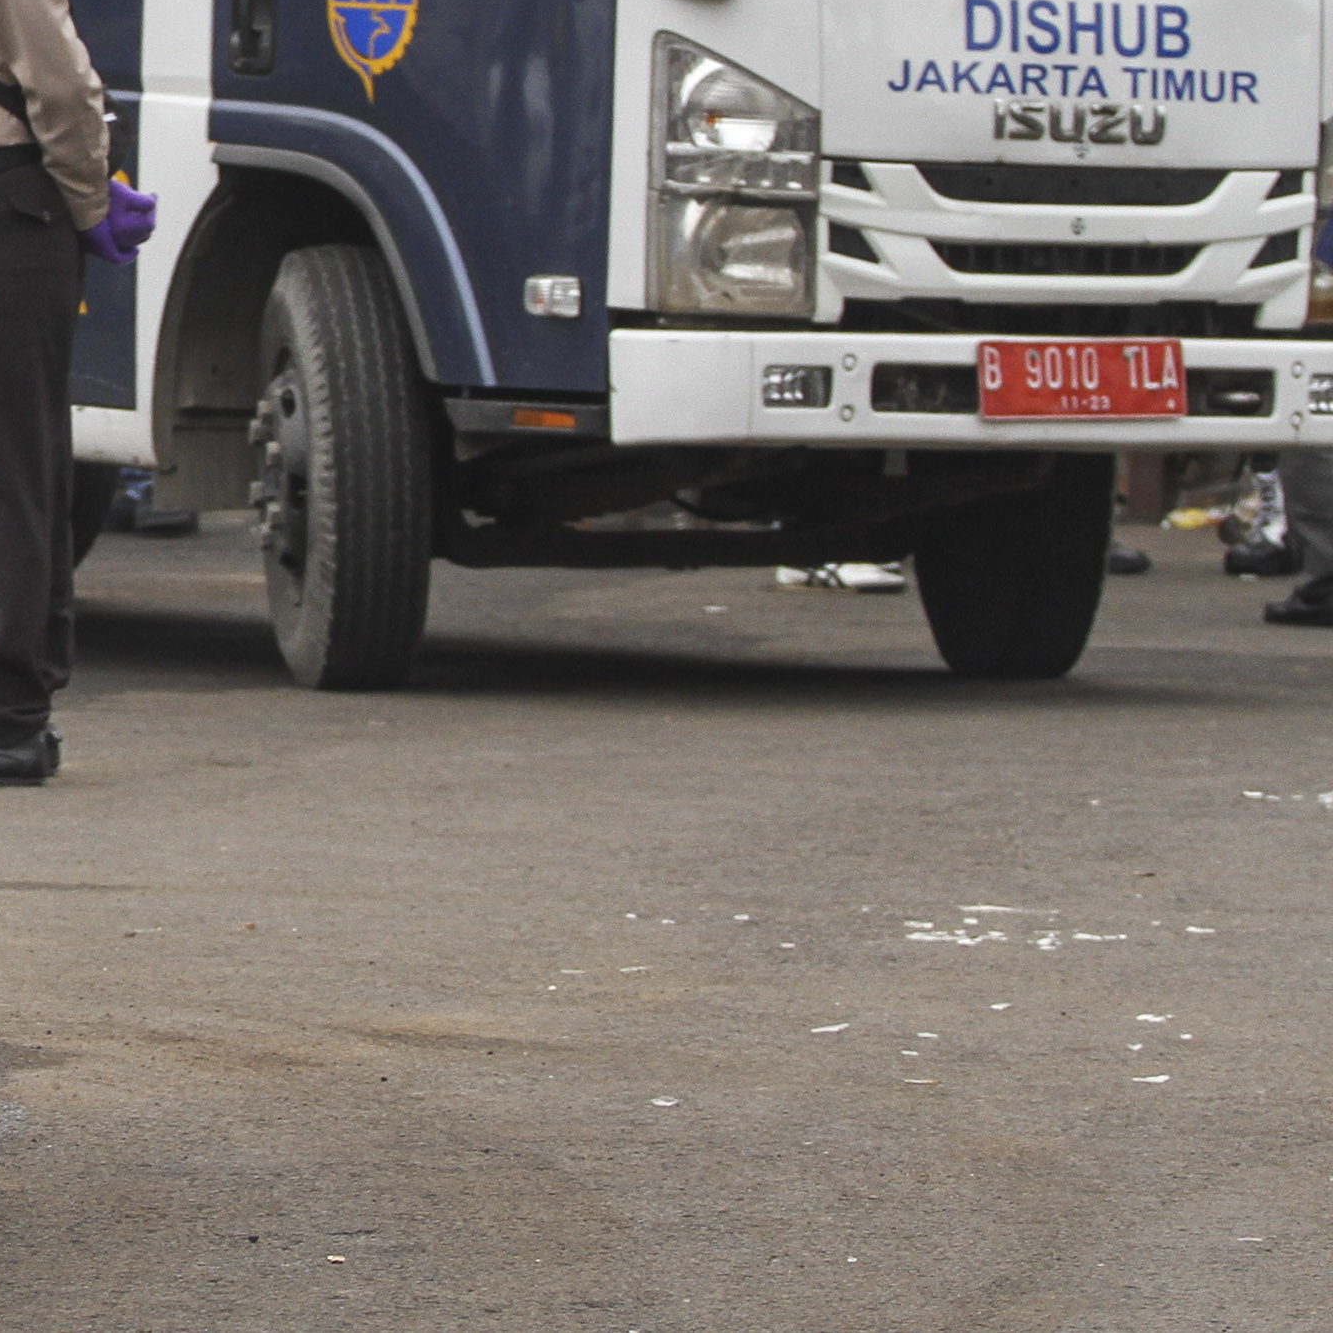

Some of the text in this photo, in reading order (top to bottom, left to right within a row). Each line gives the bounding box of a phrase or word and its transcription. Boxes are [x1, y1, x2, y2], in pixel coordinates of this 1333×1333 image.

[888, 60, 1259, 104] JAKARTA TIMUR
[992, 98, 1167, 146] ISUZU
[983, 345, 1179, 390] B 9010 TLA
